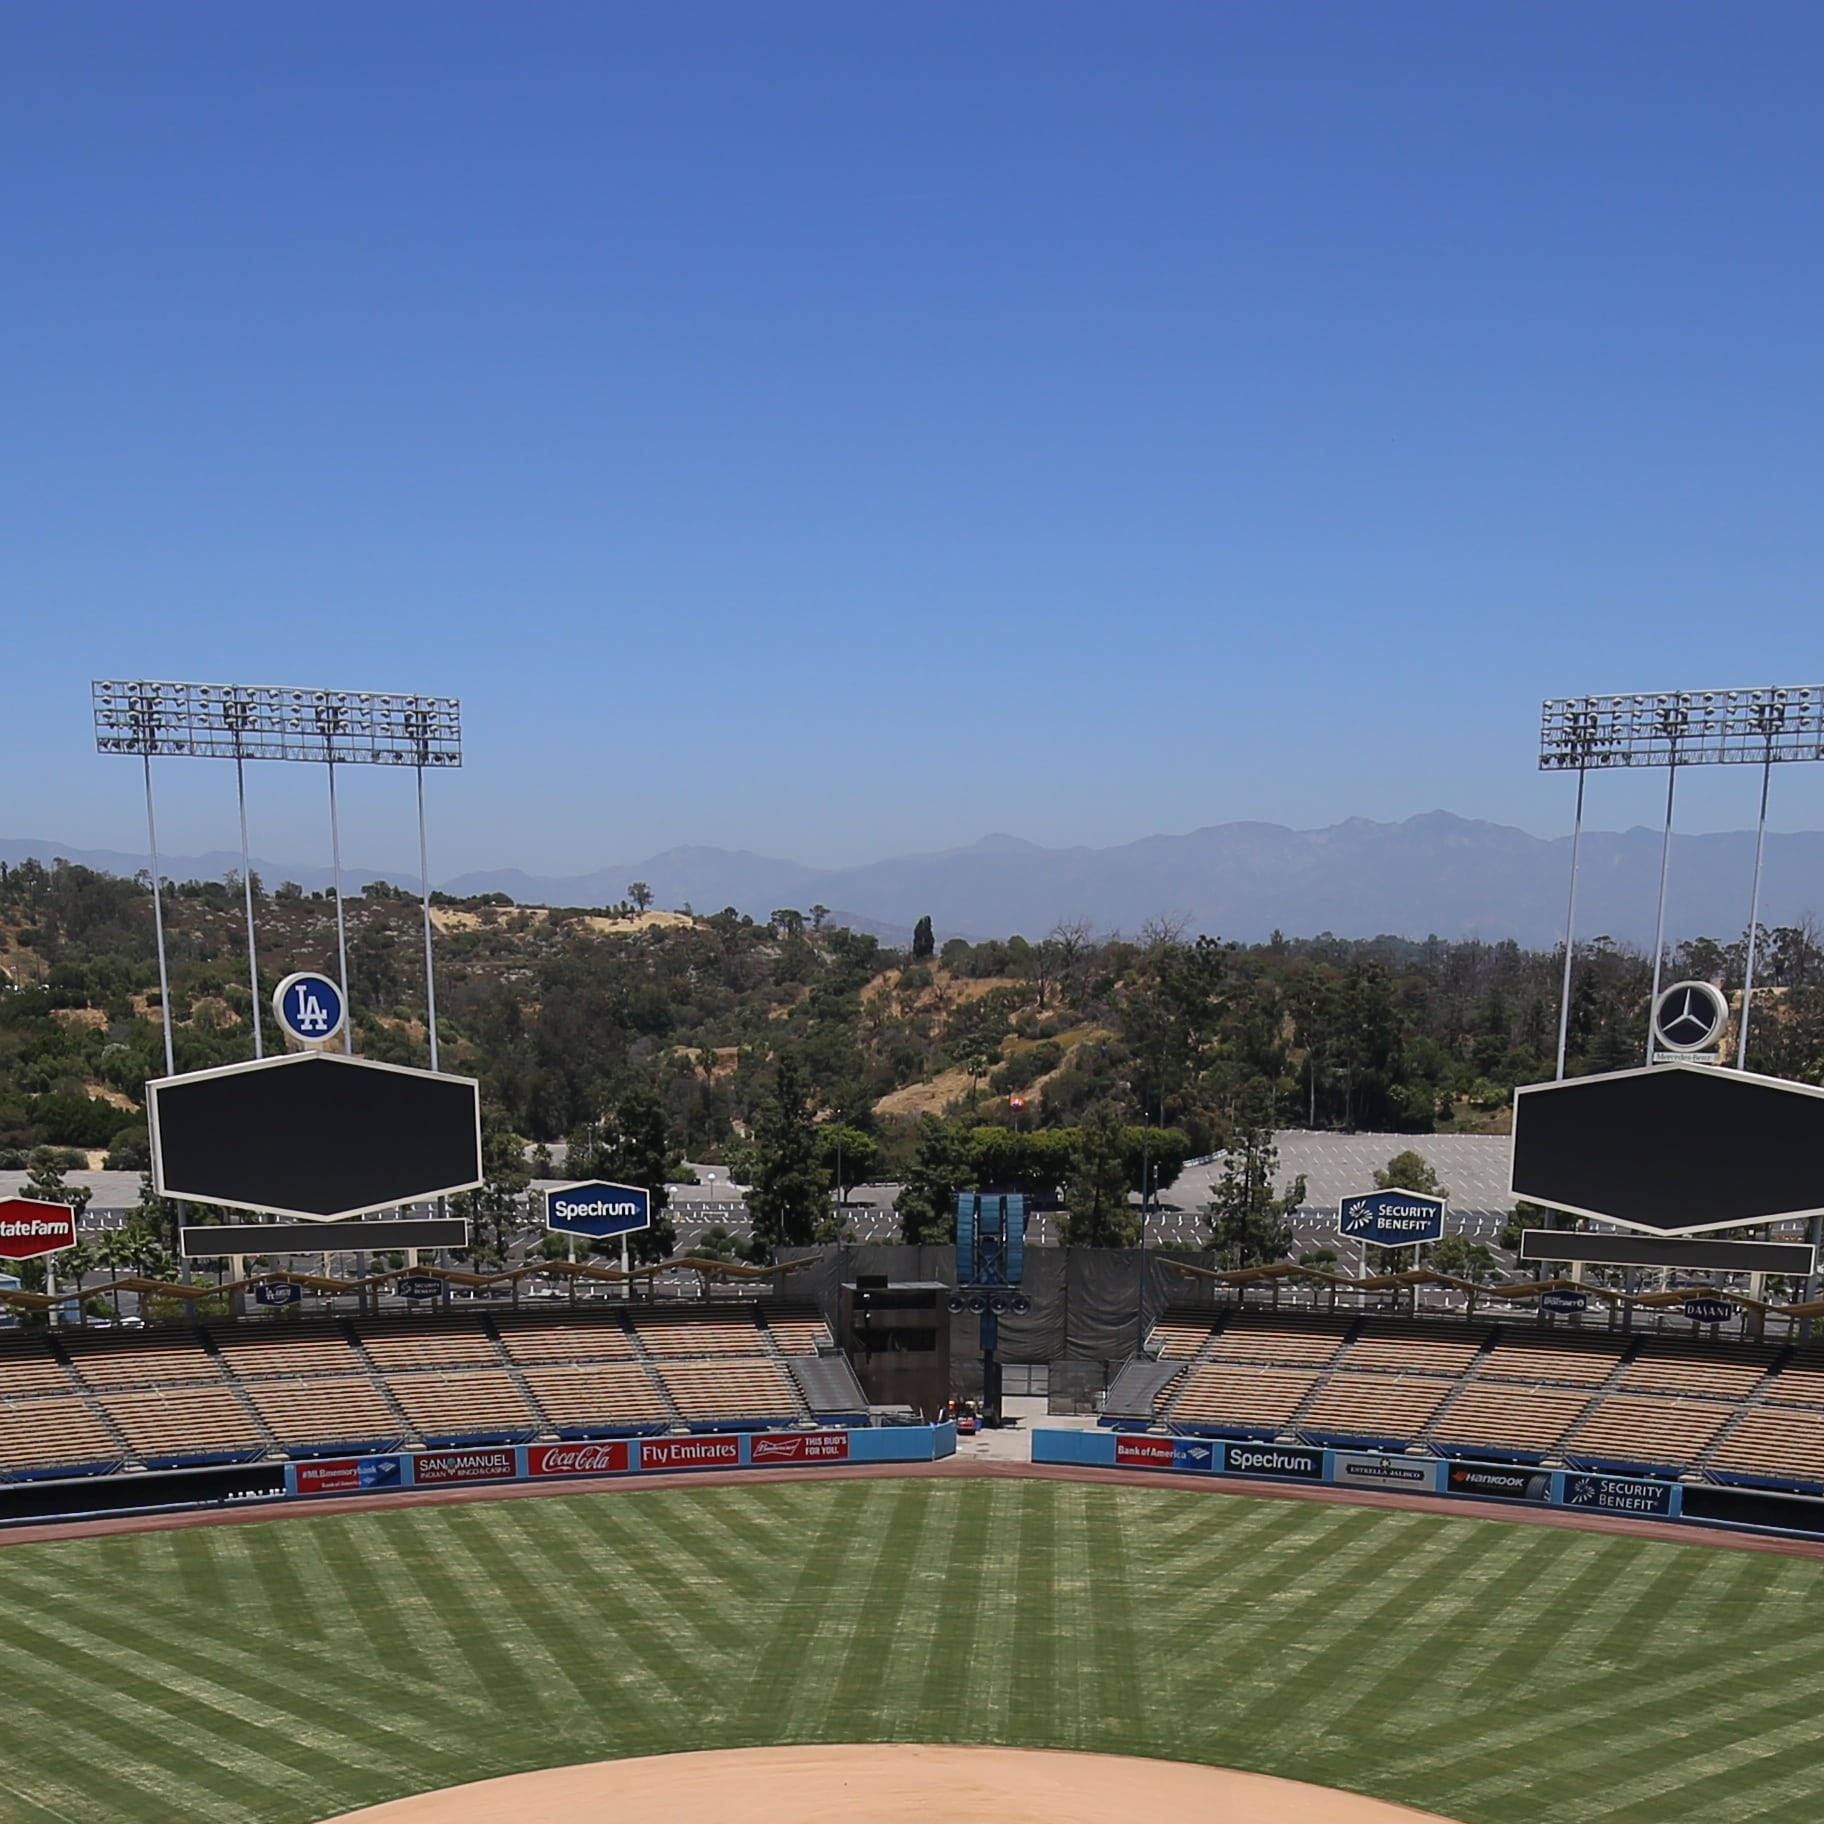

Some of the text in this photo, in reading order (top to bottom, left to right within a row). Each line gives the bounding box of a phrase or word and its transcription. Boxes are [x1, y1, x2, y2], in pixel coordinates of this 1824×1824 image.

[295, 985, 328, 1030] LA
[556, 1200, 636, 1221] Spectrum
[1378, 1204, 1436, 1218] SECURITY
[1377, 1219, 1428, 1231] BENEFIT
[1687, 1305, 1729, 1317] DASANI
[642, 1443, 737, 1463] Fly Emirates
[1117, 1445, 1187, 1460] Bank of America
[1230, 1449, 1312, 1471] Spectrum
[419, 1454, 510, 1471] SAN MANUEL
[1600, 1480, 1663, 1497] SECURITY
[1599, 1494, 1654, 1510] BENEFIT
